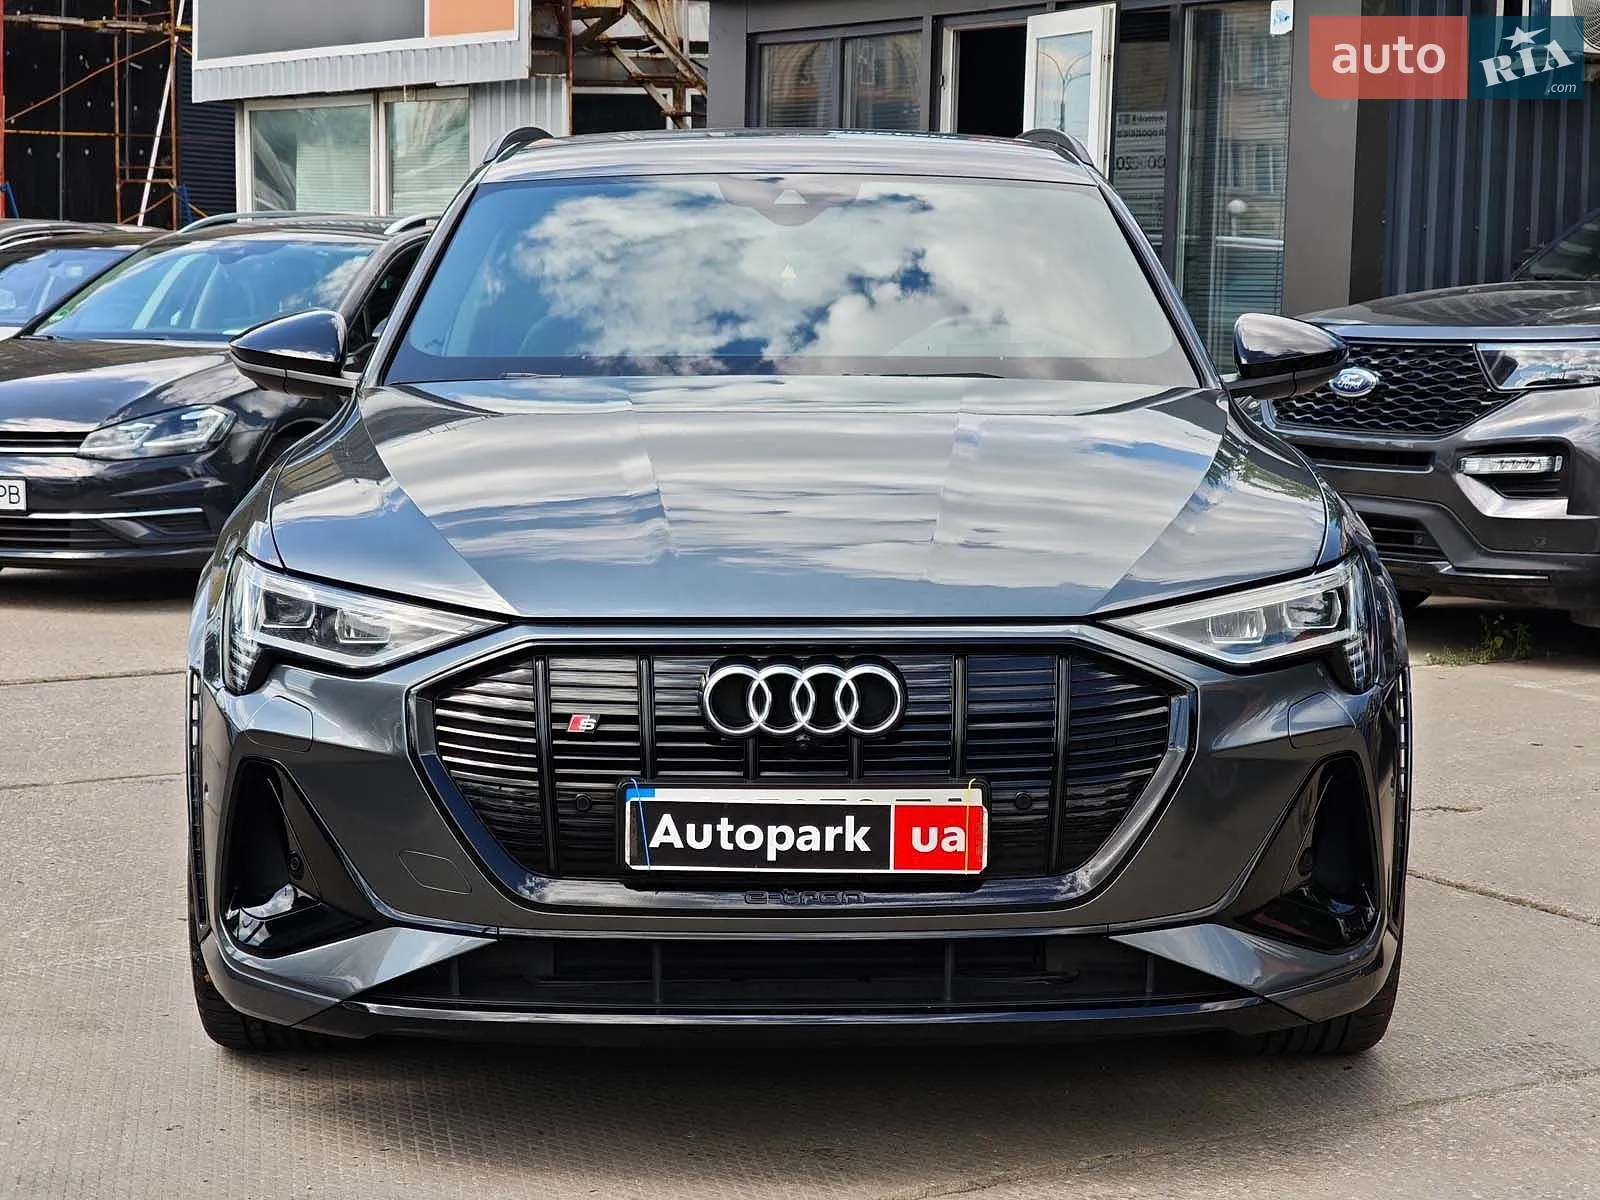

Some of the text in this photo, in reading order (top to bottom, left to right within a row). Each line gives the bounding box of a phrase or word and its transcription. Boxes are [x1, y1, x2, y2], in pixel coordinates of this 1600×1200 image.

[1337, 374, 1366, 390] Ford
[649, 813, 966, 862] Autopark ua
[745, 889, 864, 905] e-tron
